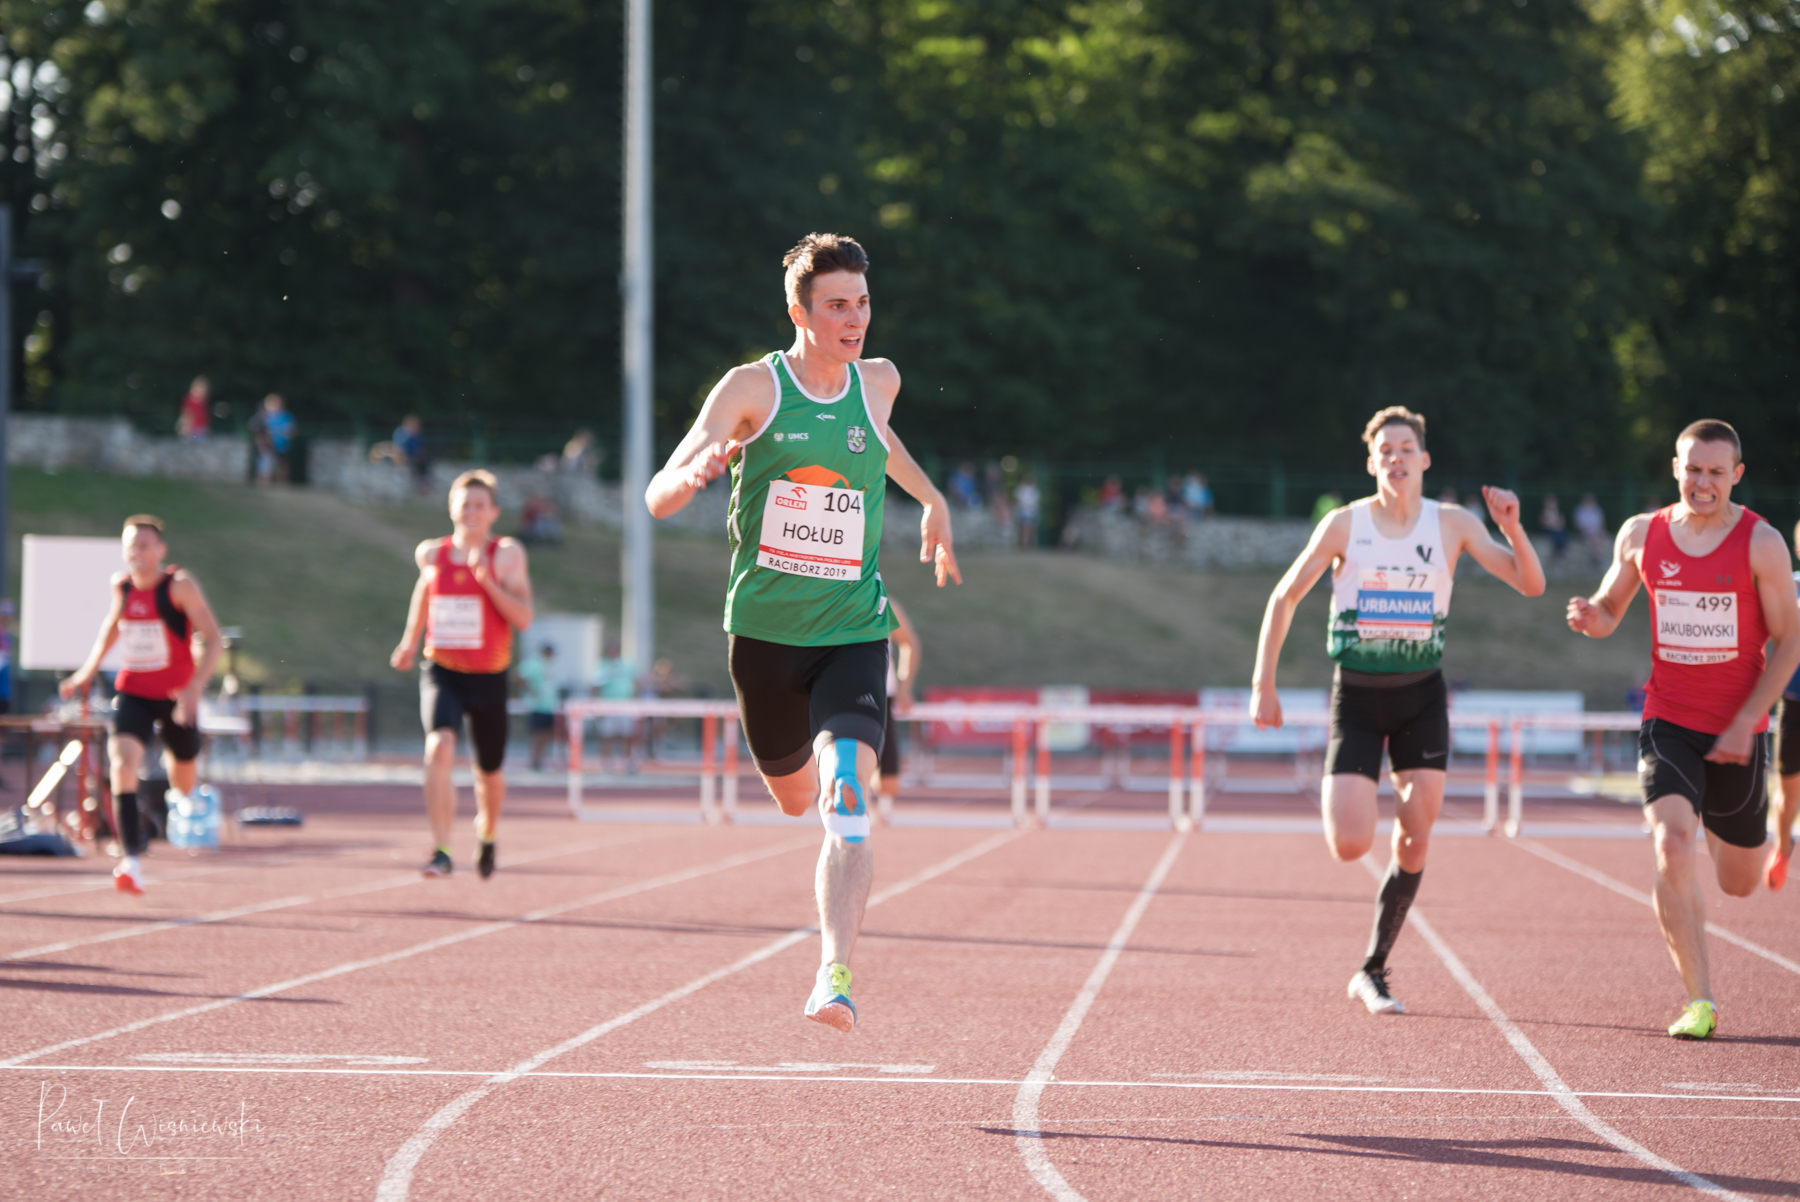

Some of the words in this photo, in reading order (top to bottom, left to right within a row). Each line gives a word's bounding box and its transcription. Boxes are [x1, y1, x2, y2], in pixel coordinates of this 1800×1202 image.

[788, 432, 809, 440] UMCS
[776, 498, 806, 510] ORLEN
[824, 492, 861, 514] 104
[782, 522, 844, 545] HOŁUB
[768, 557, 821, 575] RACIBÓRZ
[823, 567, 847, 578] 2019
[1406, 574, 1428, 590] 77
[1360, 598, 1431, 614] URBANIAK
[1695, 596, 1732, 612] 499
[1660, 622, 1734, 637] JAKUBOWSKI
